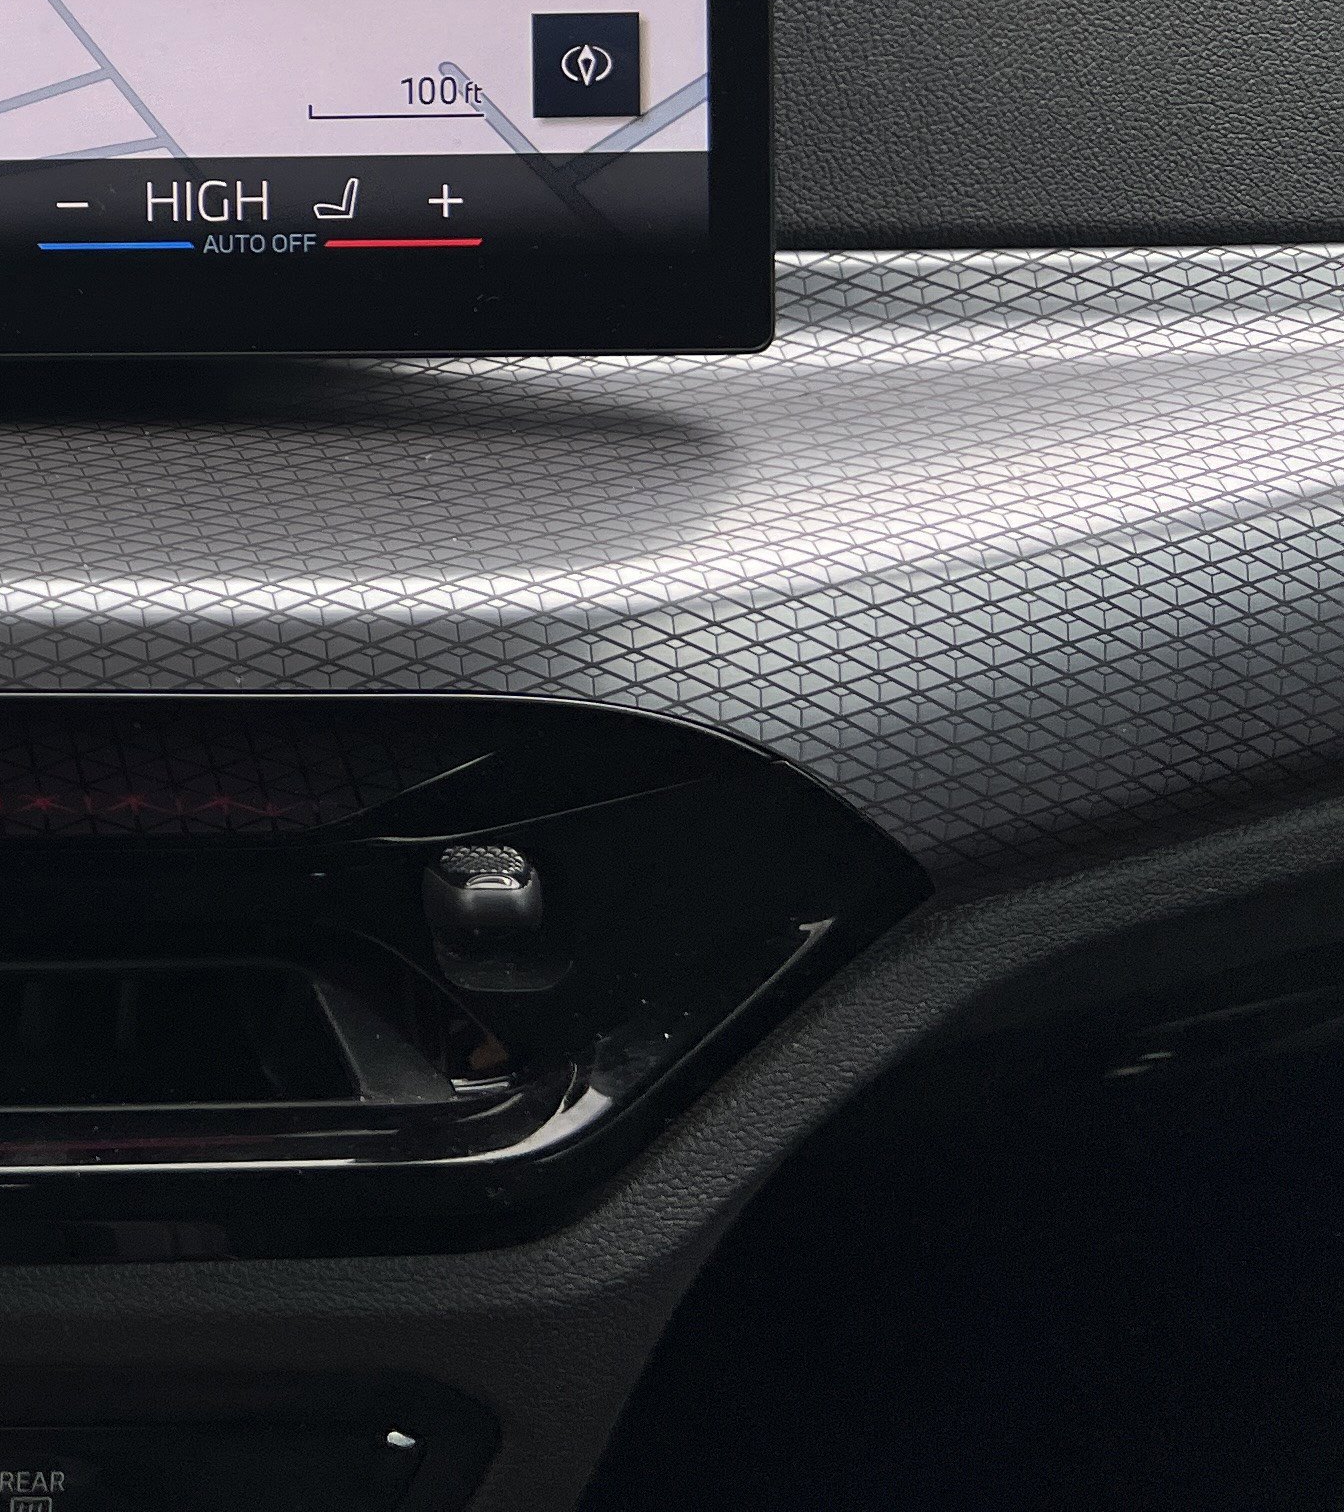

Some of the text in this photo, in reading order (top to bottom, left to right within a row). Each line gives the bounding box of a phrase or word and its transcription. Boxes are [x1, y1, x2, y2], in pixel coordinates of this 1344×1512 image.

[146, 180, 269, 221] HIGH
[203, 233, 317, 255] AUTO OFF
[0, 1471, 65, 1493] REAR
